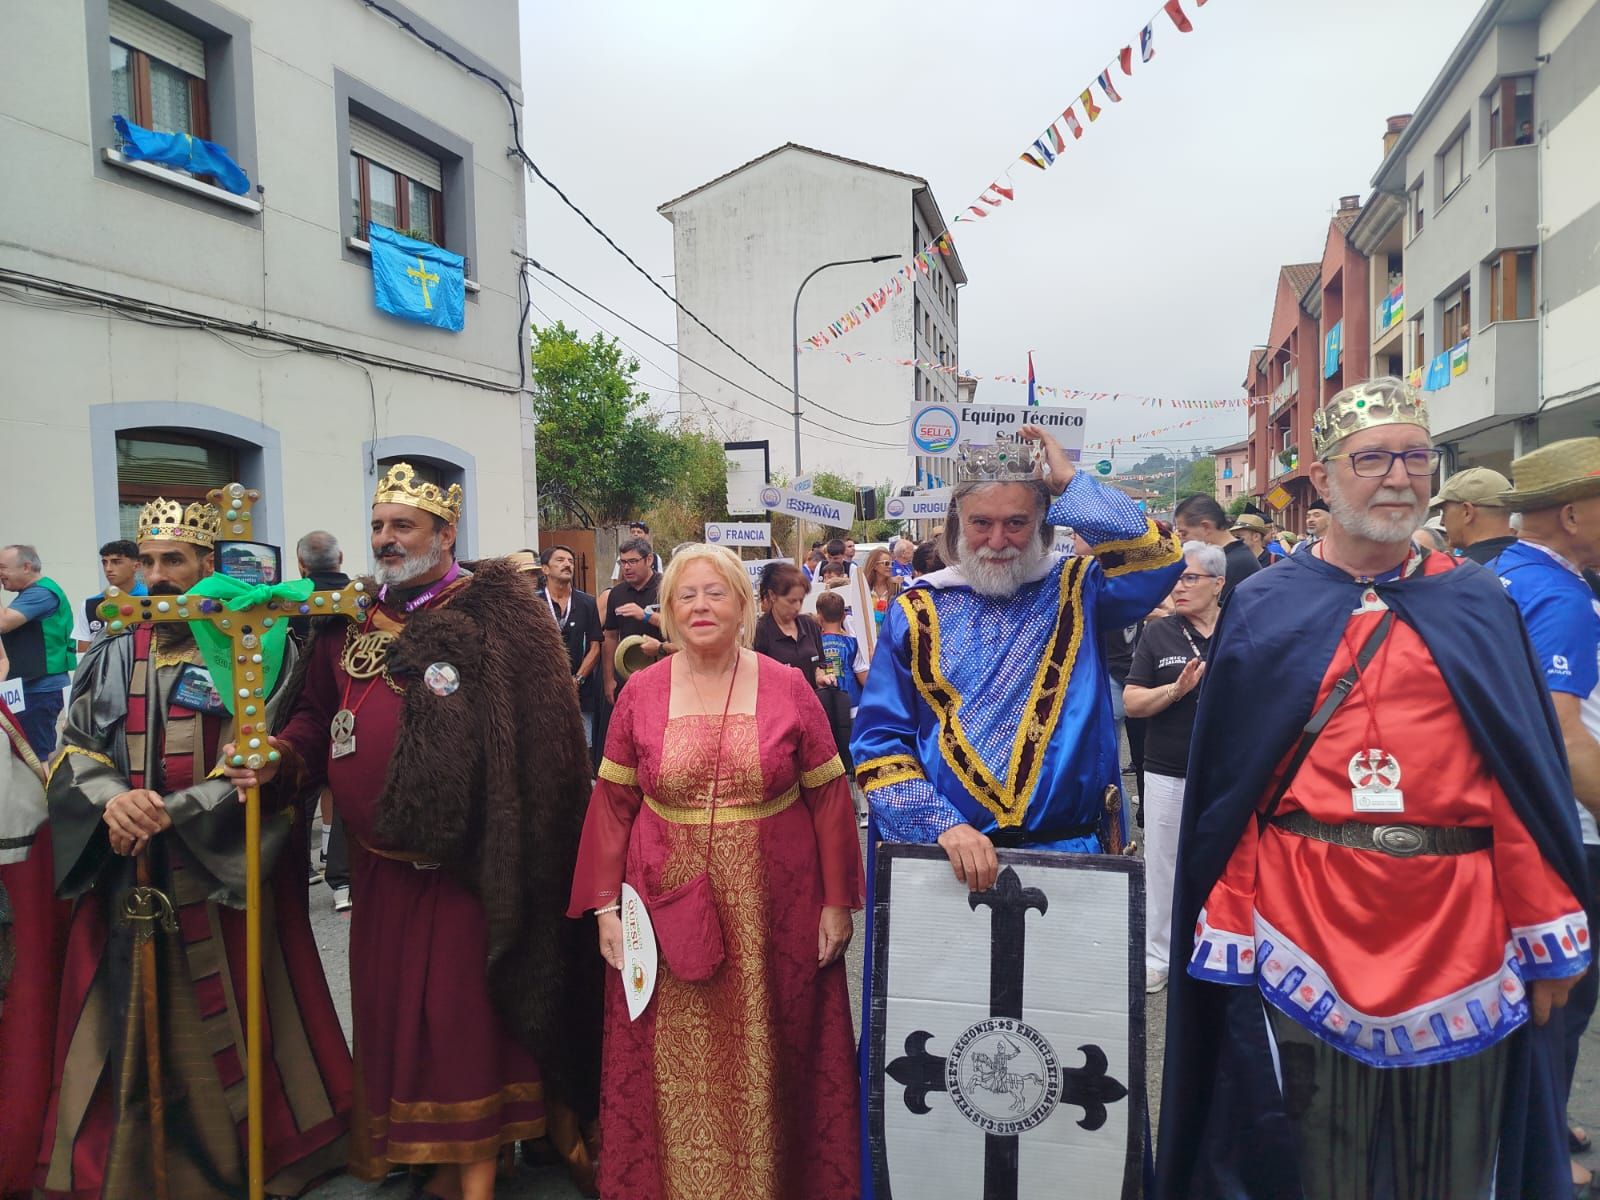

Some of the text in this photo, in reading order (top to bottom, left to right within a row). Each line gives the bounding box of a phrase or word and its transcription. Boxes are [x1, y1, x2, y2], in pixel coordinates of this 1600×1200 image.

[961, 408, 1084, 427] Equipo Técnico
[920, 427, 952, 437] SELLA
[786, 498, 840, 521] ESPAÑA
[726, 529, 765, 540] FRANCIA
